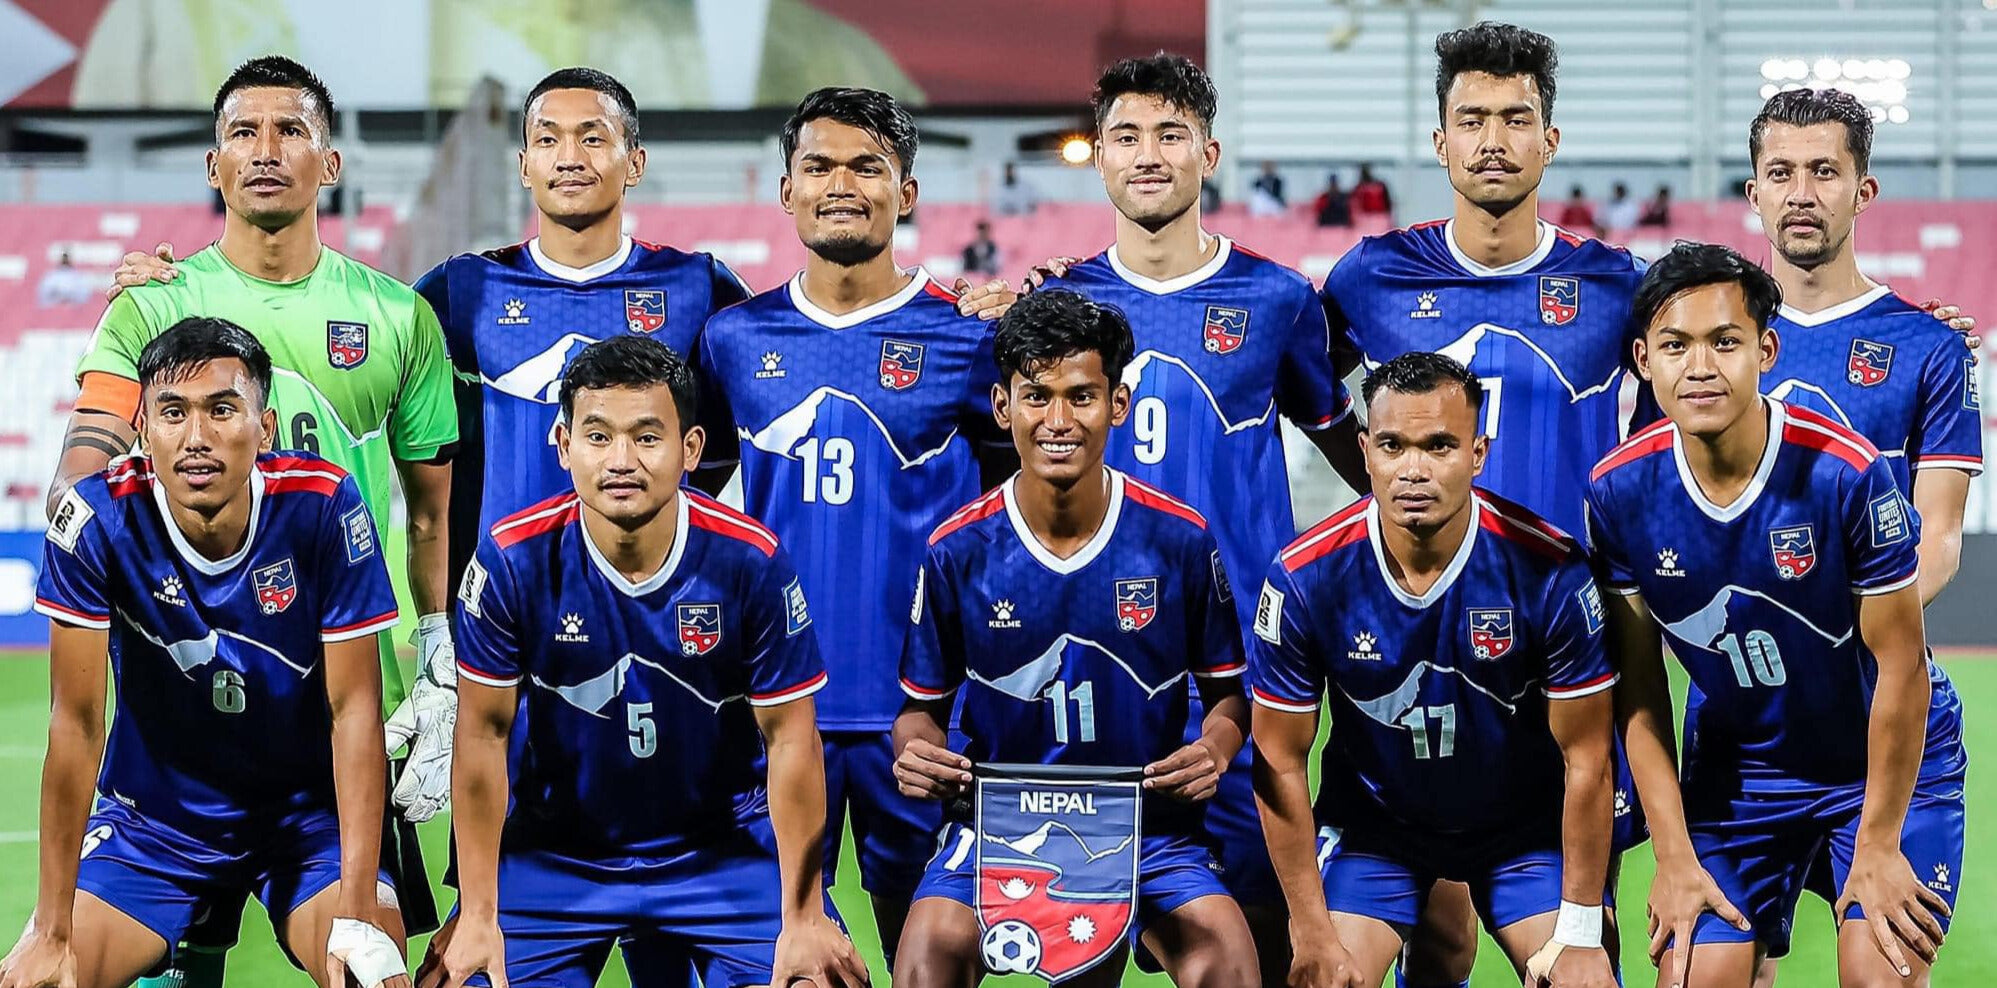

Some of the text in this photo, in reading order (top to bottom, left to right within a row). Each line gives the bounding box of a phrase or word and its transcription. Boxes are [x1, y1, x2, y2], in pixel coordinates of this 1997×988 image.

[497, 317, 530, 325] KELME
[1410, 310, 1441, 319] KELME
[755, 370, 786, 379] KELME
[1133, 396, 1168, 465] 9
[795, 437, 855, 505] 13
[1655, 569, 1686, 577] KELME
[153, 591, 186, 607] KELME
[988, 620, 1022, 628] KELME
[555, 633, 589, 642] KELME
[1347, 651, 1382, 660] KELME
[1717, 630, 1787, 688] 10
[212, 670, 246, 714] 6
[1043, 680, 1096, 744] 11
[627, 702, 657, 758] 5
[1400, 703, 1456, 759] 17
[1020, 791, 1097, 815] NEPAL
